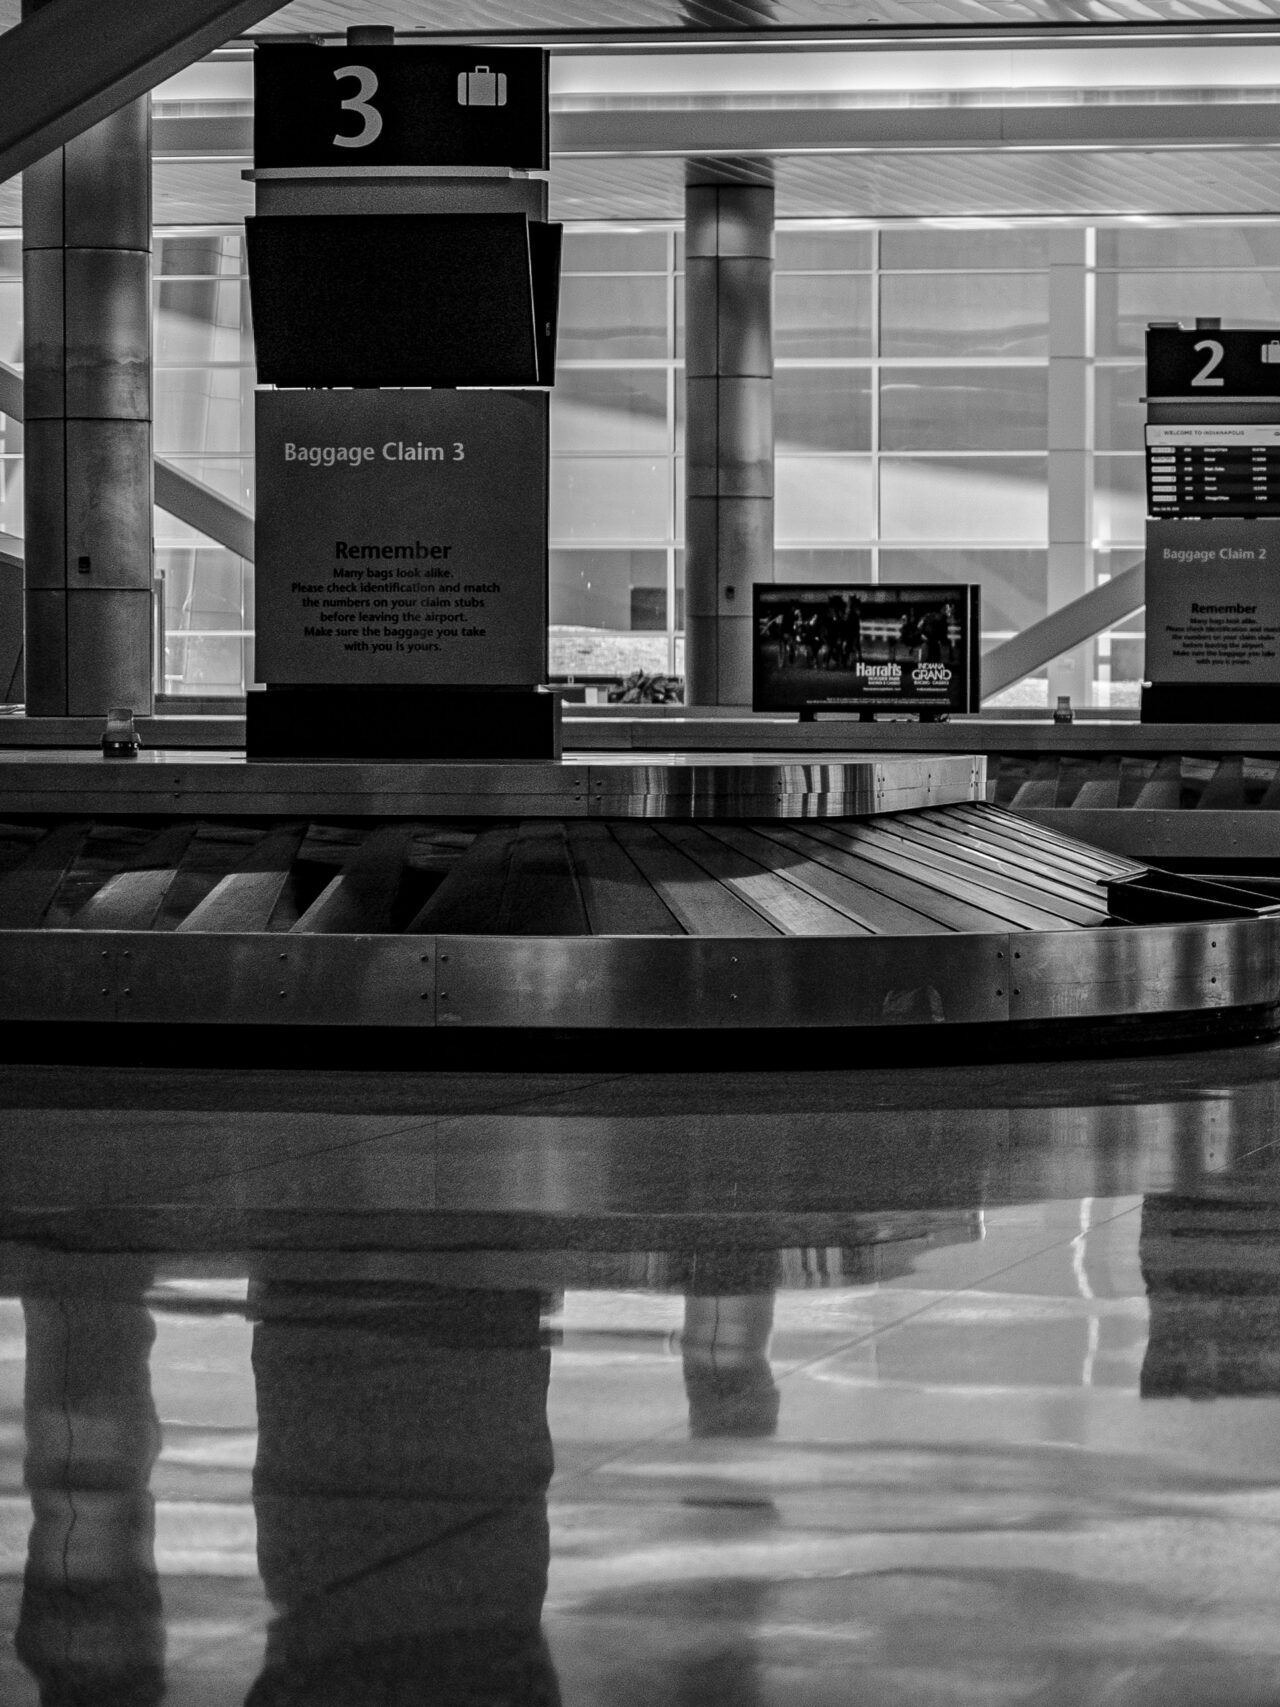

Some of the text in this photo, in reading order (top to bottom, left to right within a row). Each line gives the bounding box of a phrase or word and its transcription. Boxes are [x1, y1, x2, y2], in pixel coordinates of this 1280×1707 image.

[332, 64, 383, 148] 3
[1191, 340, 1224, 386] 2
[284, 441, 465, 466] Baggage Claim 3
[335, 540, 452, 559] Remember
[1163, 548, 1267, 562] Baggage Claim 2
[333, 568, 454, 580] Many bags look alike.
[291, 583, 500, 593] Please check identification and match
[302, 597, 485, 610] the numbers on your claim stubs
[1192, 603, 1257, 613] Remember
[320, 612, 468, 624] before leaving the airport.
[304, 627, 486, 639] Make sure the baggage you take
[344, 641, 442, 653] with you is yours.
[856, 662, 902, 677] Harrah's
[912, 669, 952, 680] GRAND
